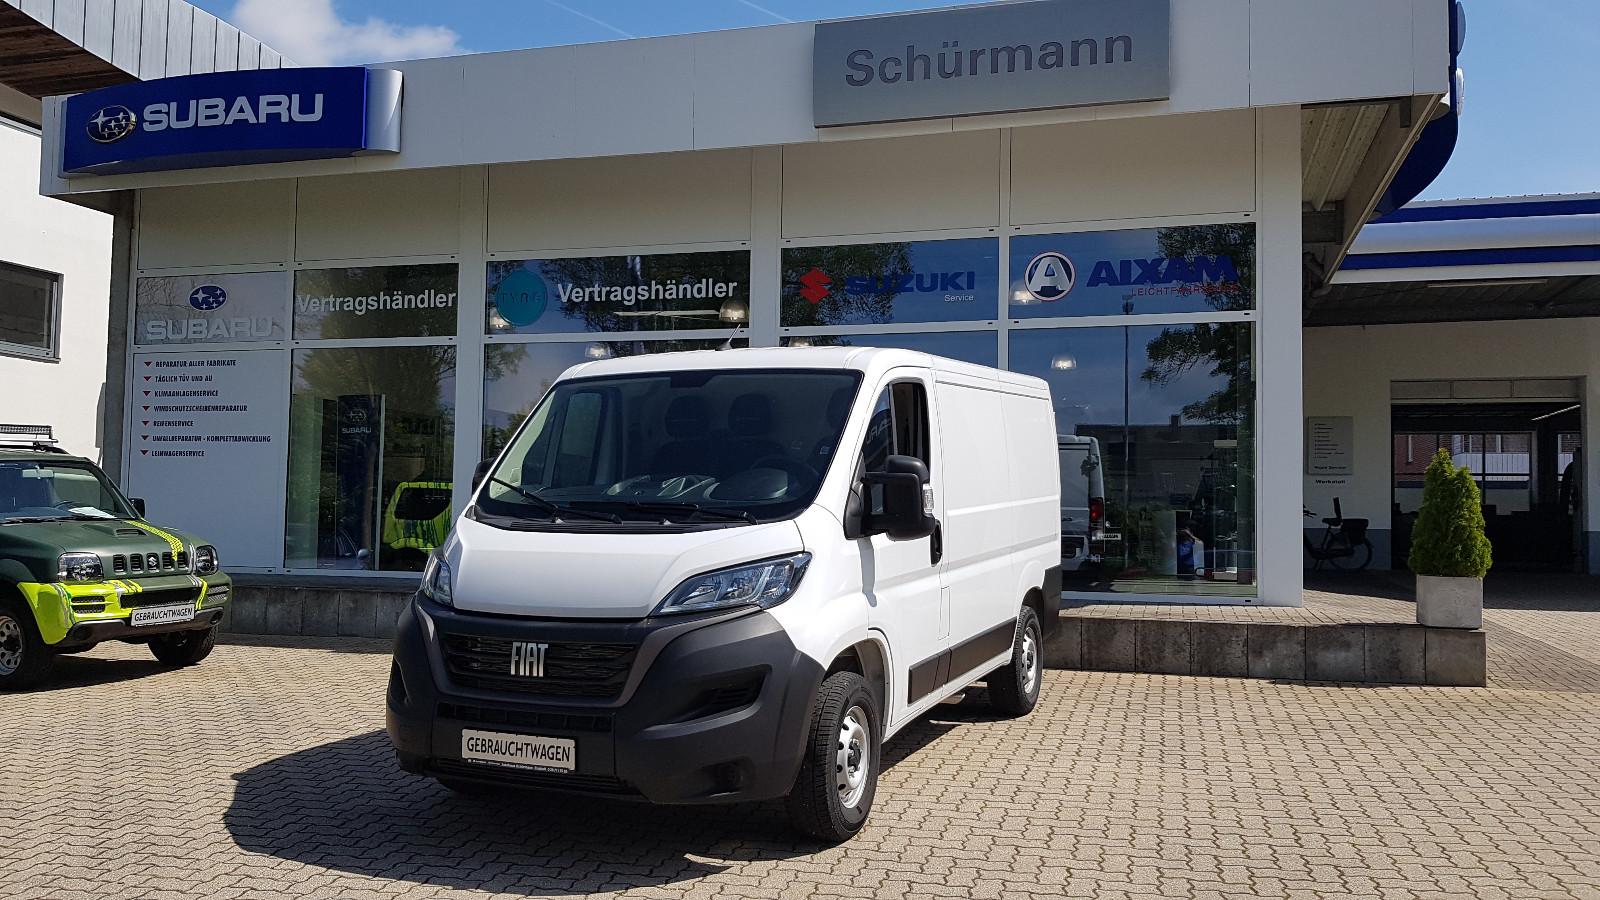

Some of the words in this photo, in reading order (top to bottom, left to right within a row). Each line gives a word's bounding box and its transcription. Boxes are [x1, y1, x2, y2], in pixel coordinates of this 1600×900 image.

[845, 33, 1132, 87] Schürmann
[143, 93, 324, 132] SUBARU
[844, 271, 975, 295] SUZUKI
[1086, 255, 1239, 287] AIXAM
[557, 277, 738, 306] Vertragshändler
[944, 294, 974, 302] Service
[297, 291, 457, 317] Vertragshändler
[146, 316, 273, 340] SUBARU
[155, 360, 187, 368] REPARATUR
[206, 359, 237, 367] FABRIKATE
[155, 374, 178, 383] TÄGLICH
[179, 373, 190, 382] TÜV
[206, 434, 271, 442] KOMPLETTABWICKLUNG
[341, 426, 372, 434] SUBARU
[134, 608, 193, 622] GEBRAUCHTWAGEN
[510, 641, 549, 678] FIAT
[466, 736, 571, 762] GEBRAUCHTWAGEN
